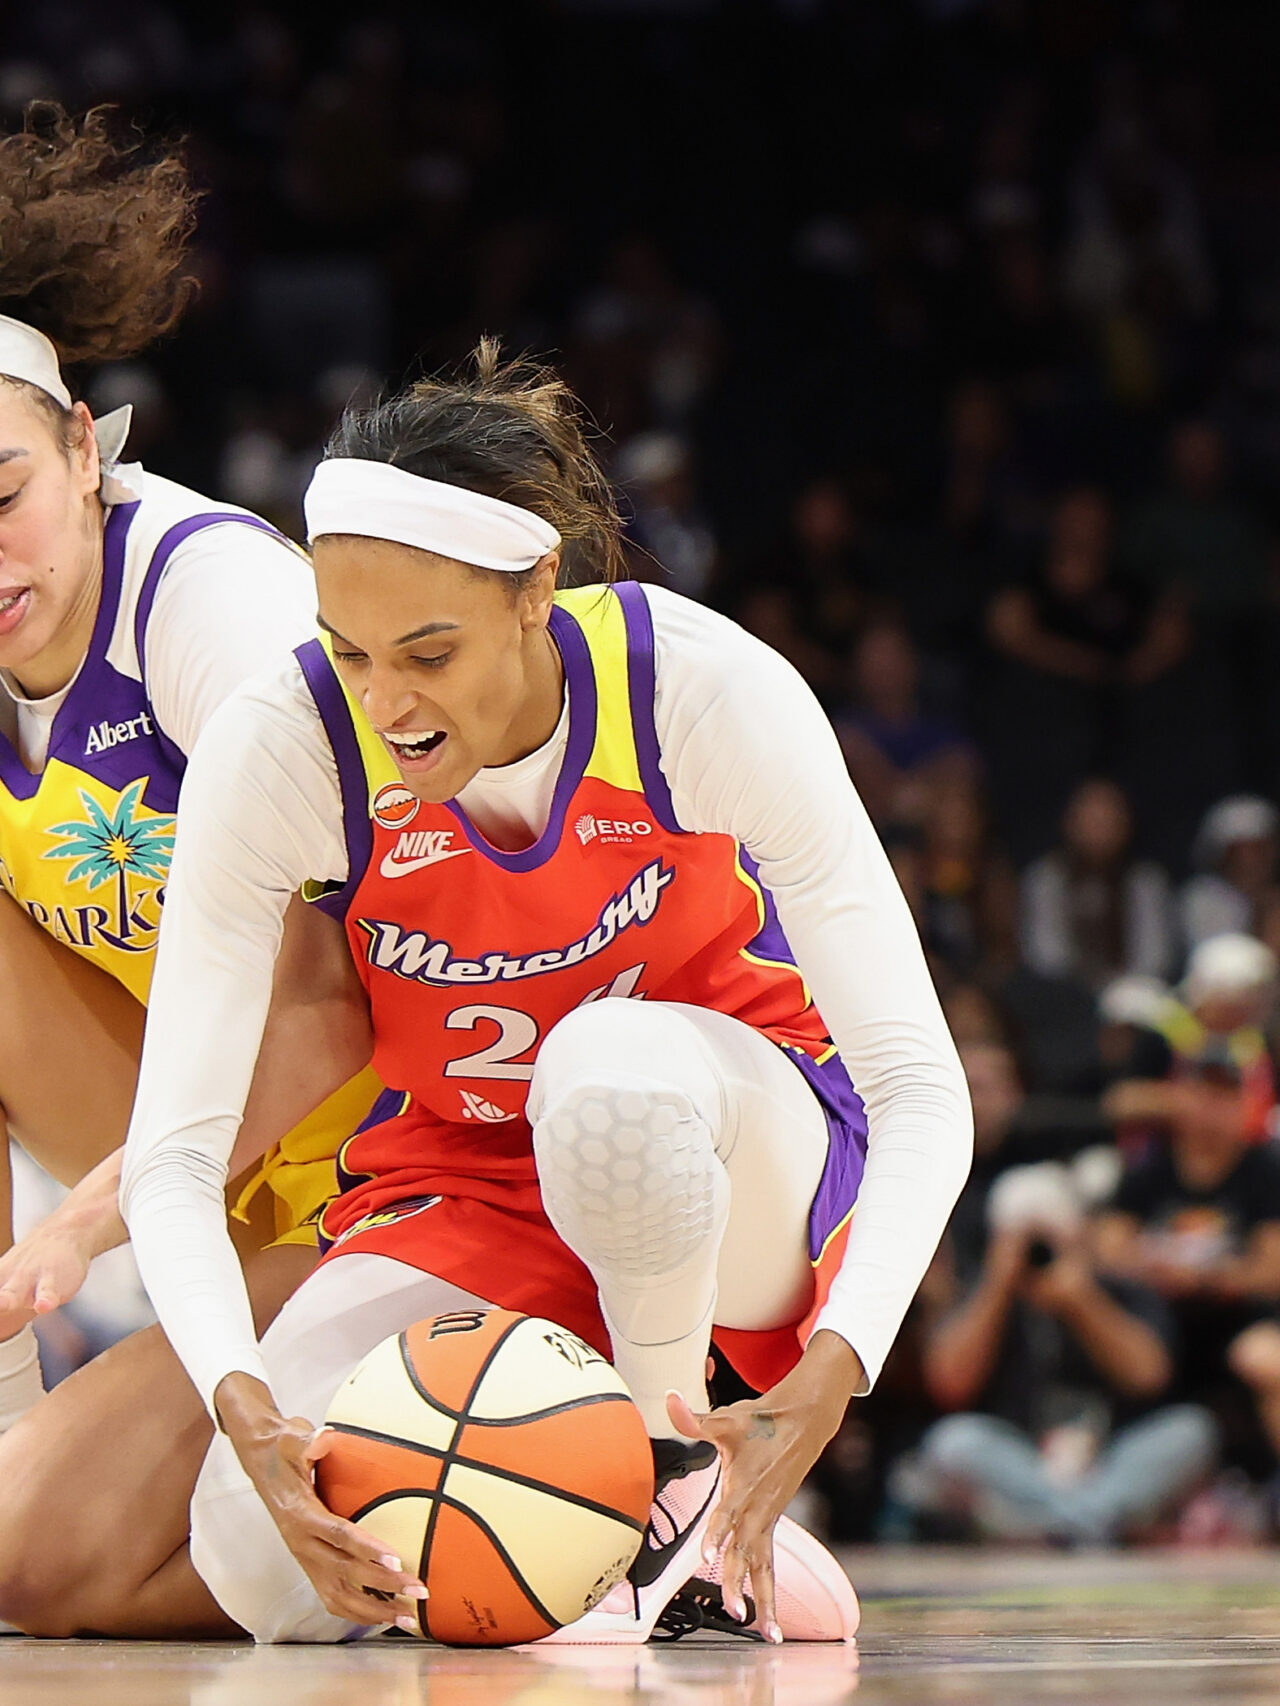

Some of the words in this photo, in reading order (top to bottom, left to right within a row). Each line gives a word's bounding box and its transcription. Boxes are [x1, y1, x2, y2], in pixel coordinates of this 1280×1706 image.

[84, 711, 154, 756] Albert
[392, 831, 455, 859] NIKE
[575, 814, 652, 846] HERO
[600, 836, 633, 844] BREAD
[368, 860, 673, 985] Mercury
